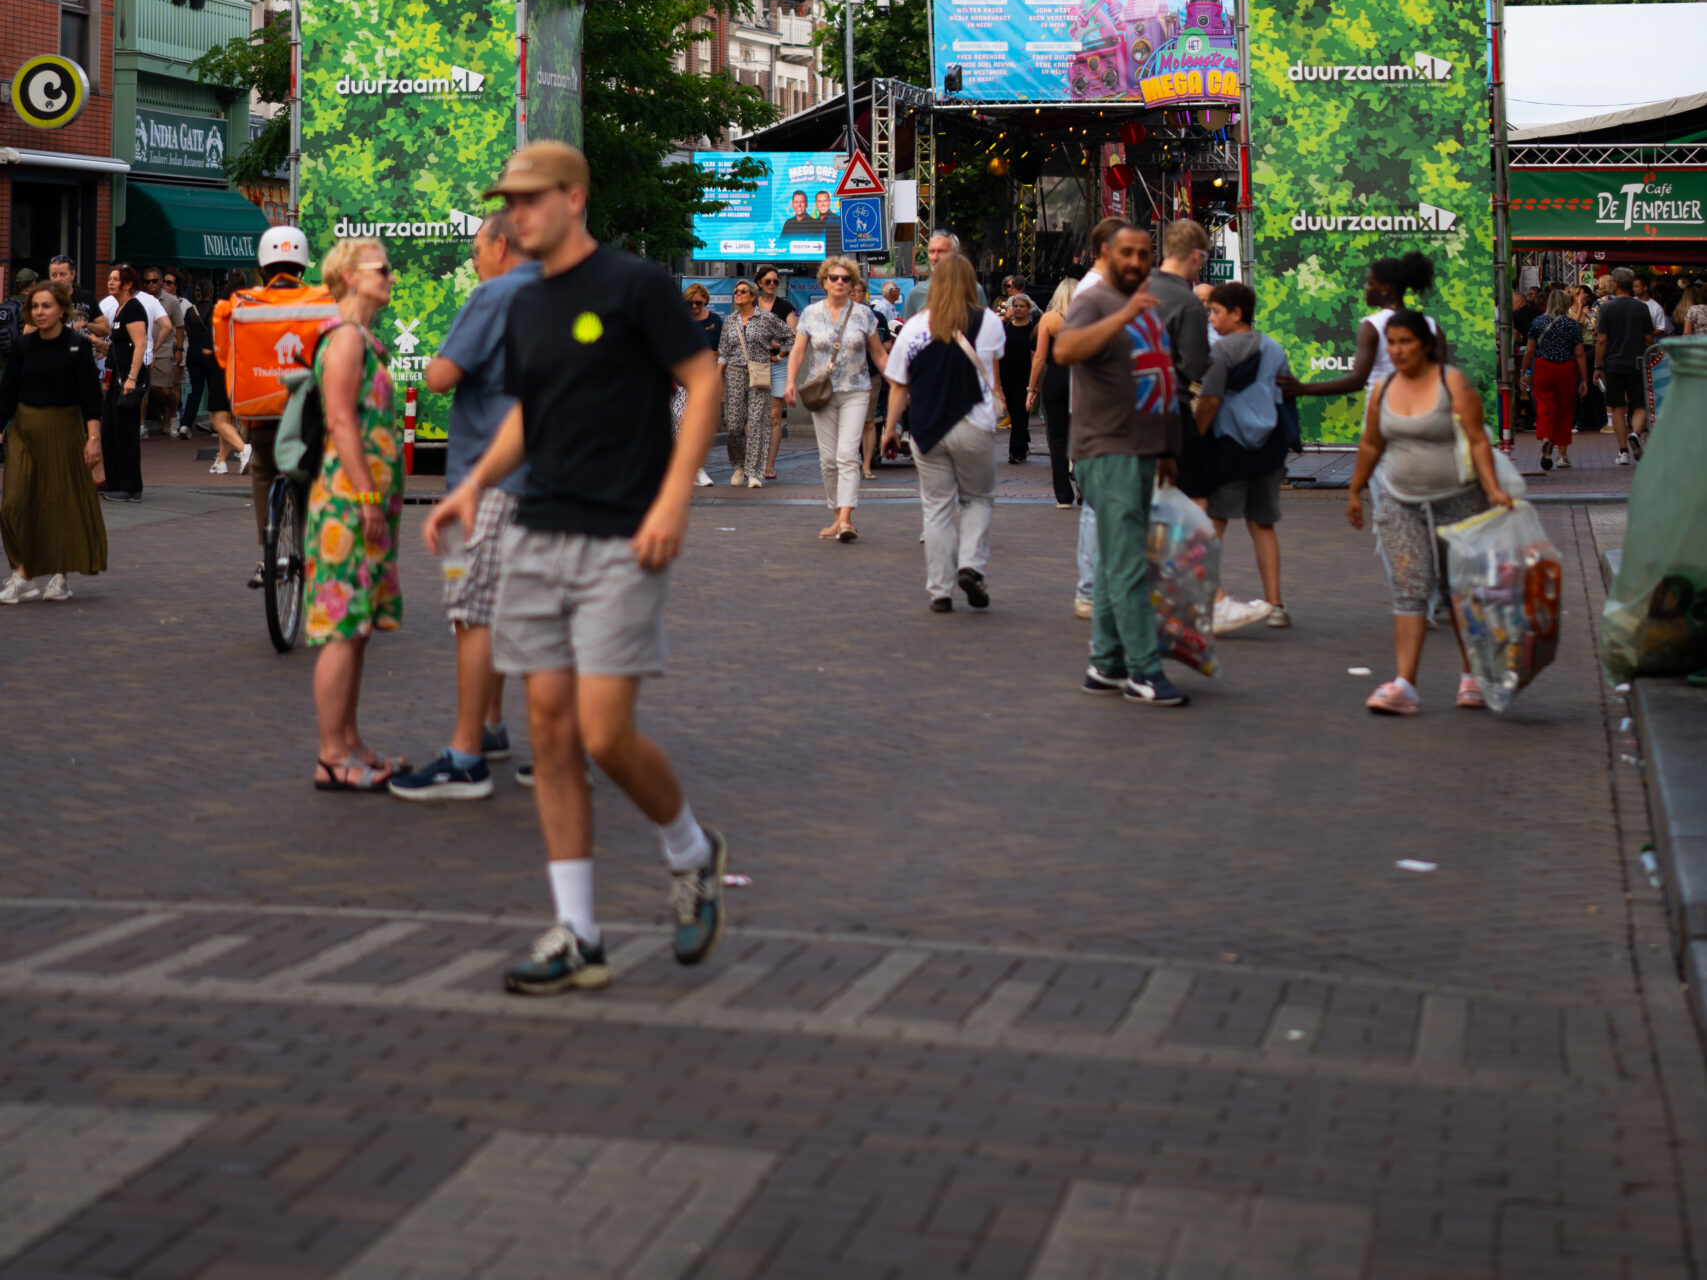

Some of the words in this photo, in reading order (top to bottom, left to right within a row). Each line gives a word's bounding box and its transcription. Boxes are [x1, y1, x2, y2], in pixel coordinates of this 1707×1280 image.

[1140, 71, 1203, 103] MEGA
[1207, 71, 1240, 97] CA
[150, 120, 178, 149] INDIA
[179, 123, 204, 153] GATE
[1645, 183, 1673, 197] Café
[203, 234, 231, 256] INDIA
[231, 235, 255, 257] GATE
[1310, 356, 1355, 370] MOLE
